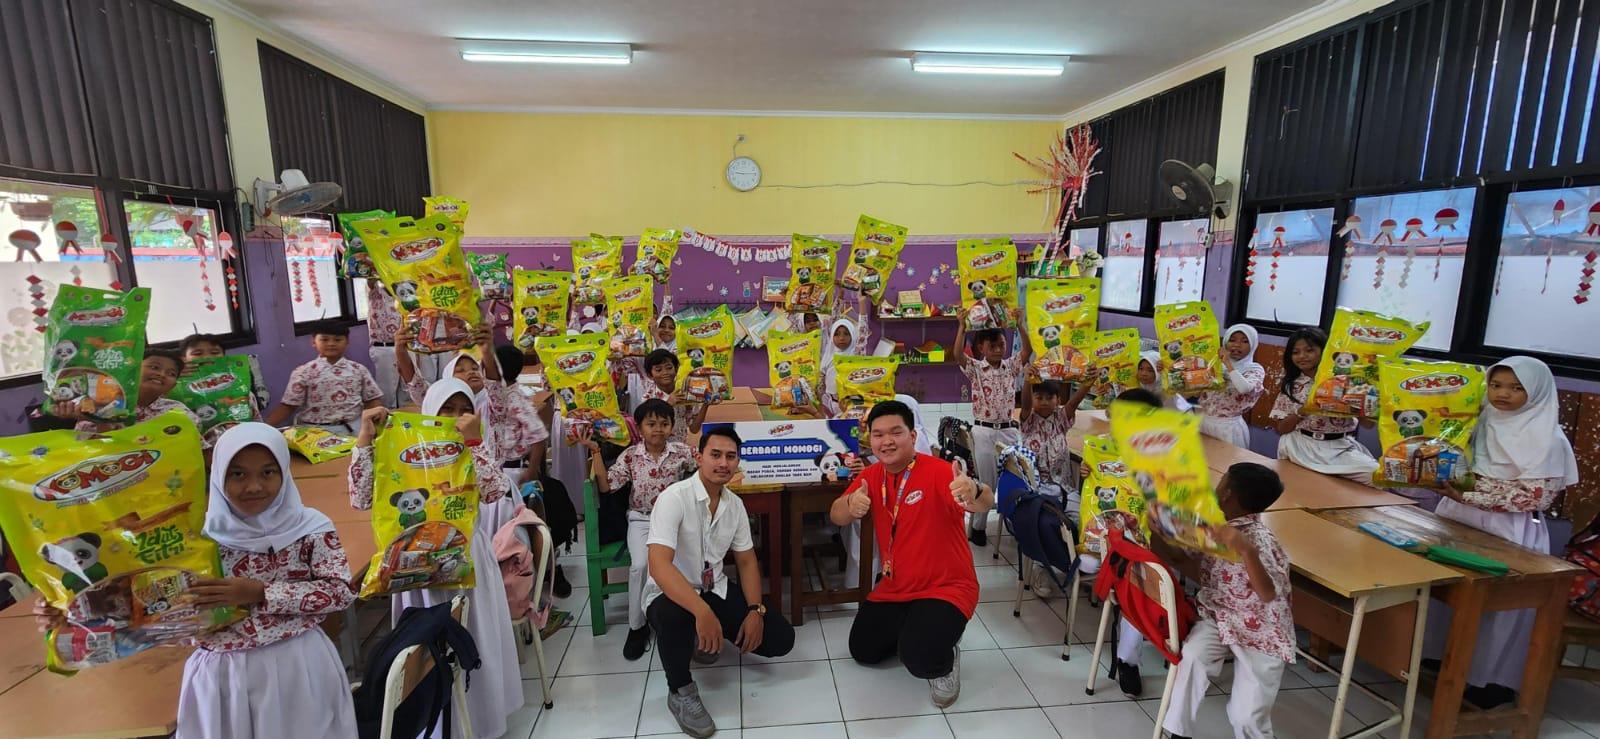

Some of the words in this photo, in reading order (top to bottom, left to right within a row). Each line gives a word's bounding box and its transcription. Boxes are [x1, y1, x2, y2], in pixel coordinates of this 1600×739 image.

[1405, 375, 1465, 390] MOMOGI
[741, 446, 780, 455] BERBAGI
[784, 445, 822, 453] MOMOGI
